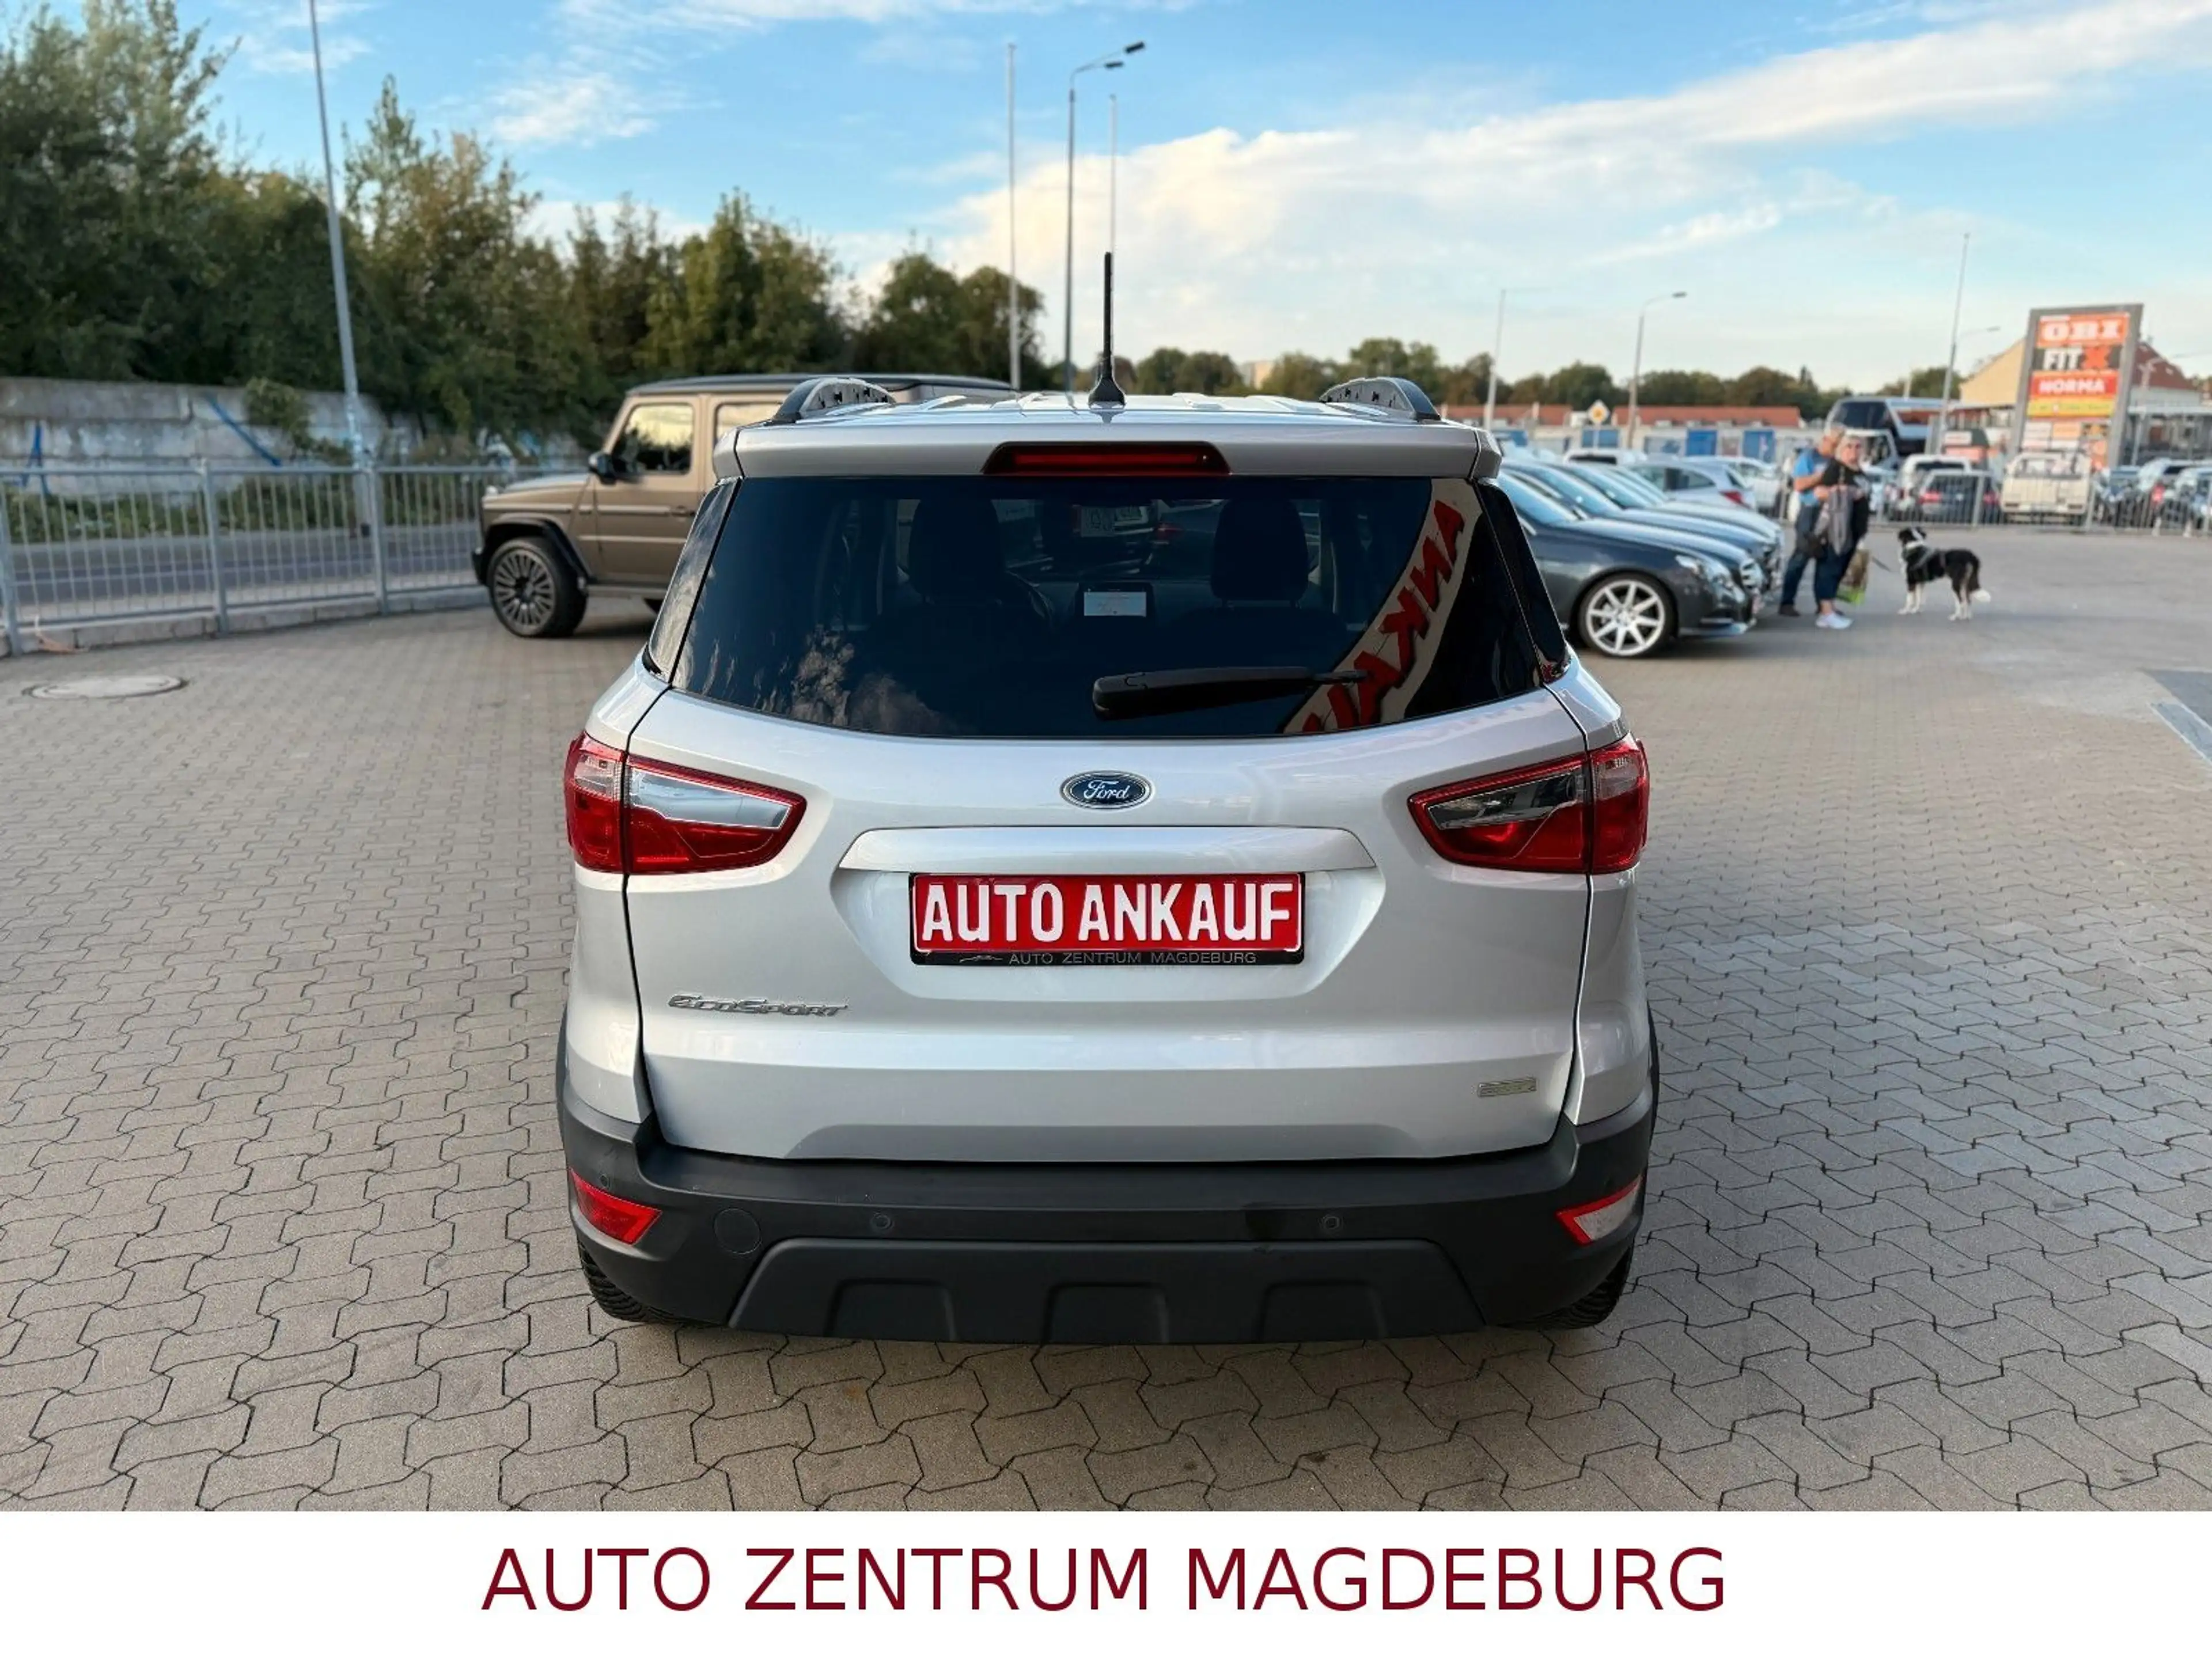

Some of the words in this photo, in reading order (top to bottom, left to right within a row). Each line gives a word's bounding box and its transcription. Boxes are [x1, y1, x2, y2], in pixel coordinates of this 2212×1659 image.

[2040, 378, 2105, 394] NORMA
[1084, 780, 1130, 799] Ford
[922, 884, 1064, 942] AUTO
[1078, 883, 1294, 942] ANKAUF
[1009, 953, 1054, 965] AUTO
[1062, 952, 1141, 964] ZENTRUM
[1152, 952, 1256, 964] MAGDEBURG
